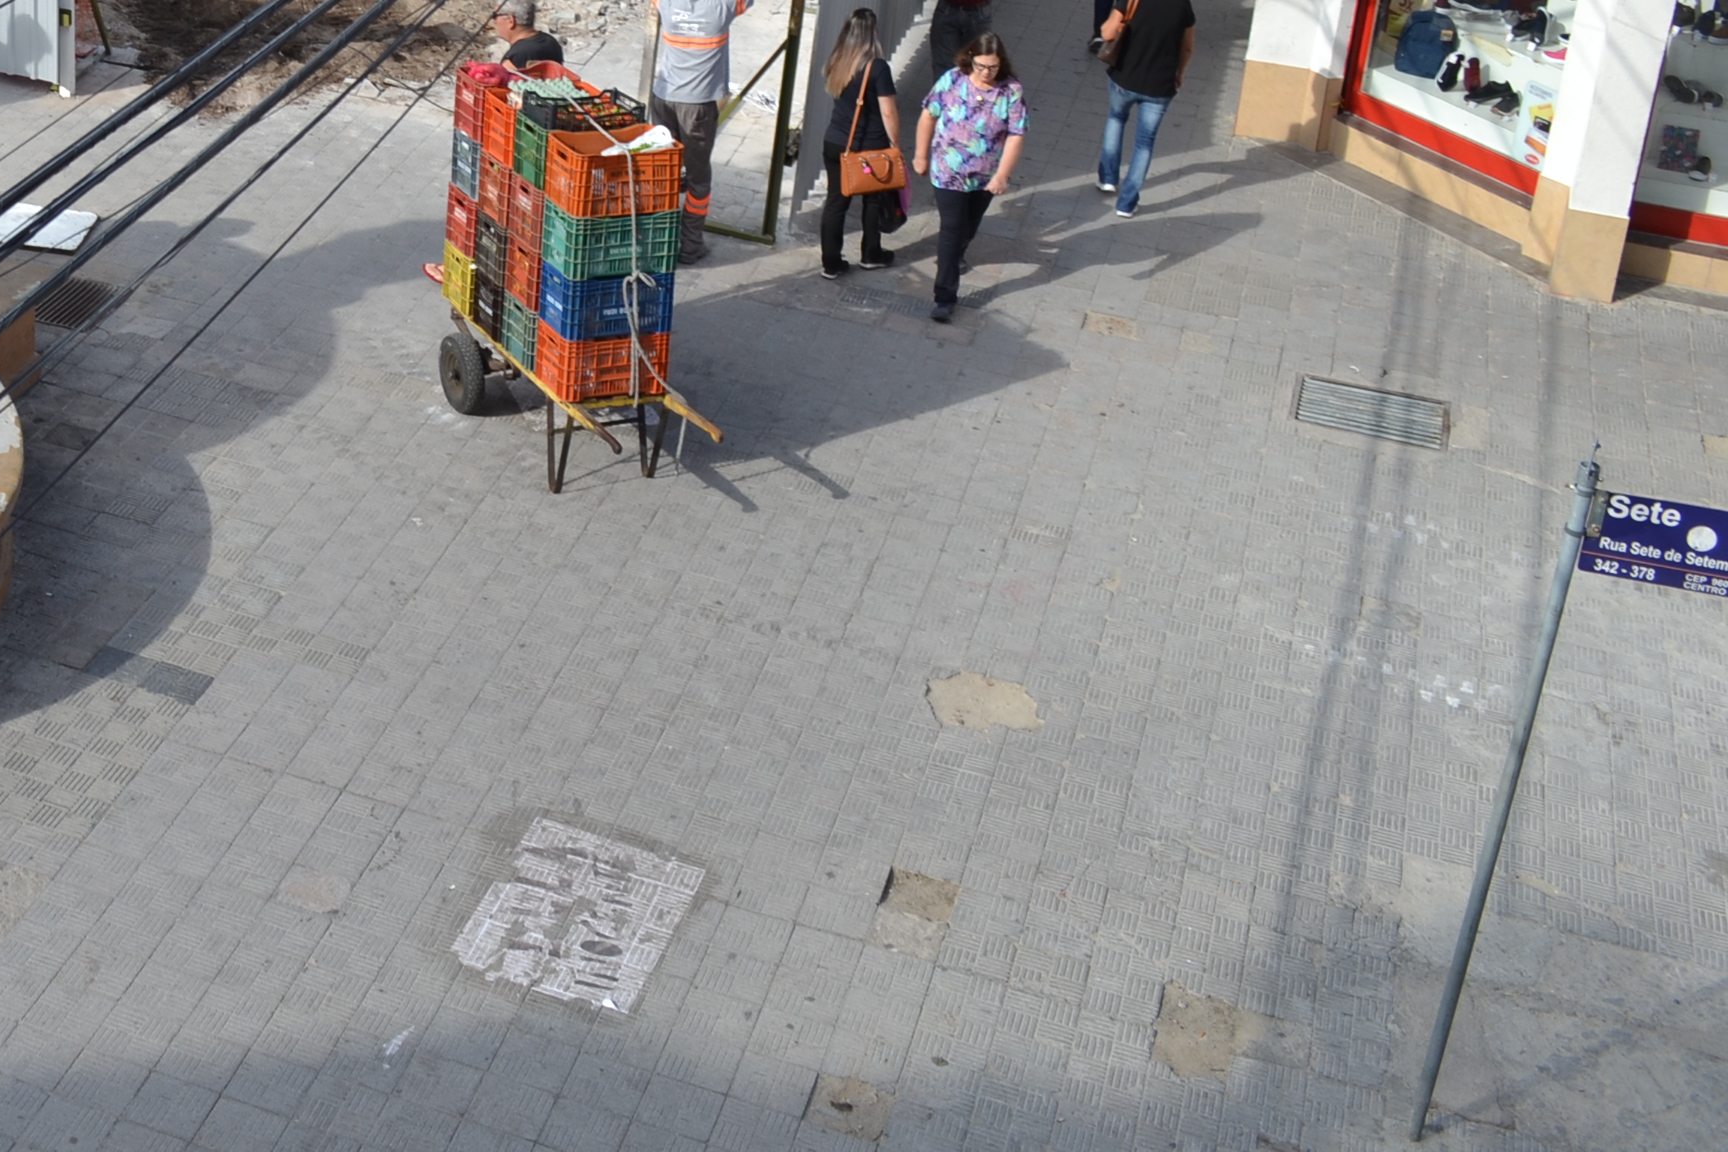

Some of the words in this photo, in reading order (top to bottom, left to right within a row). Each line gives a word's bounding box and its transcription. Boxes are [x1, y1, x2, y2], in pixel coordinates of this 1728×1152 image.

[1607, 494, 1682, 527] Sete
[1599, 536, 1627, 553] Rua
[1630, 541, 1662, 559] Sete
[1664, 548, 1682, 563] de
[1593, 558, 1620, 574] 342
[1630, 565, 1655, 581] 378
[1685, 573, 1708, 584] CEP
[1683, 581, 1728, 596] CENTRO
